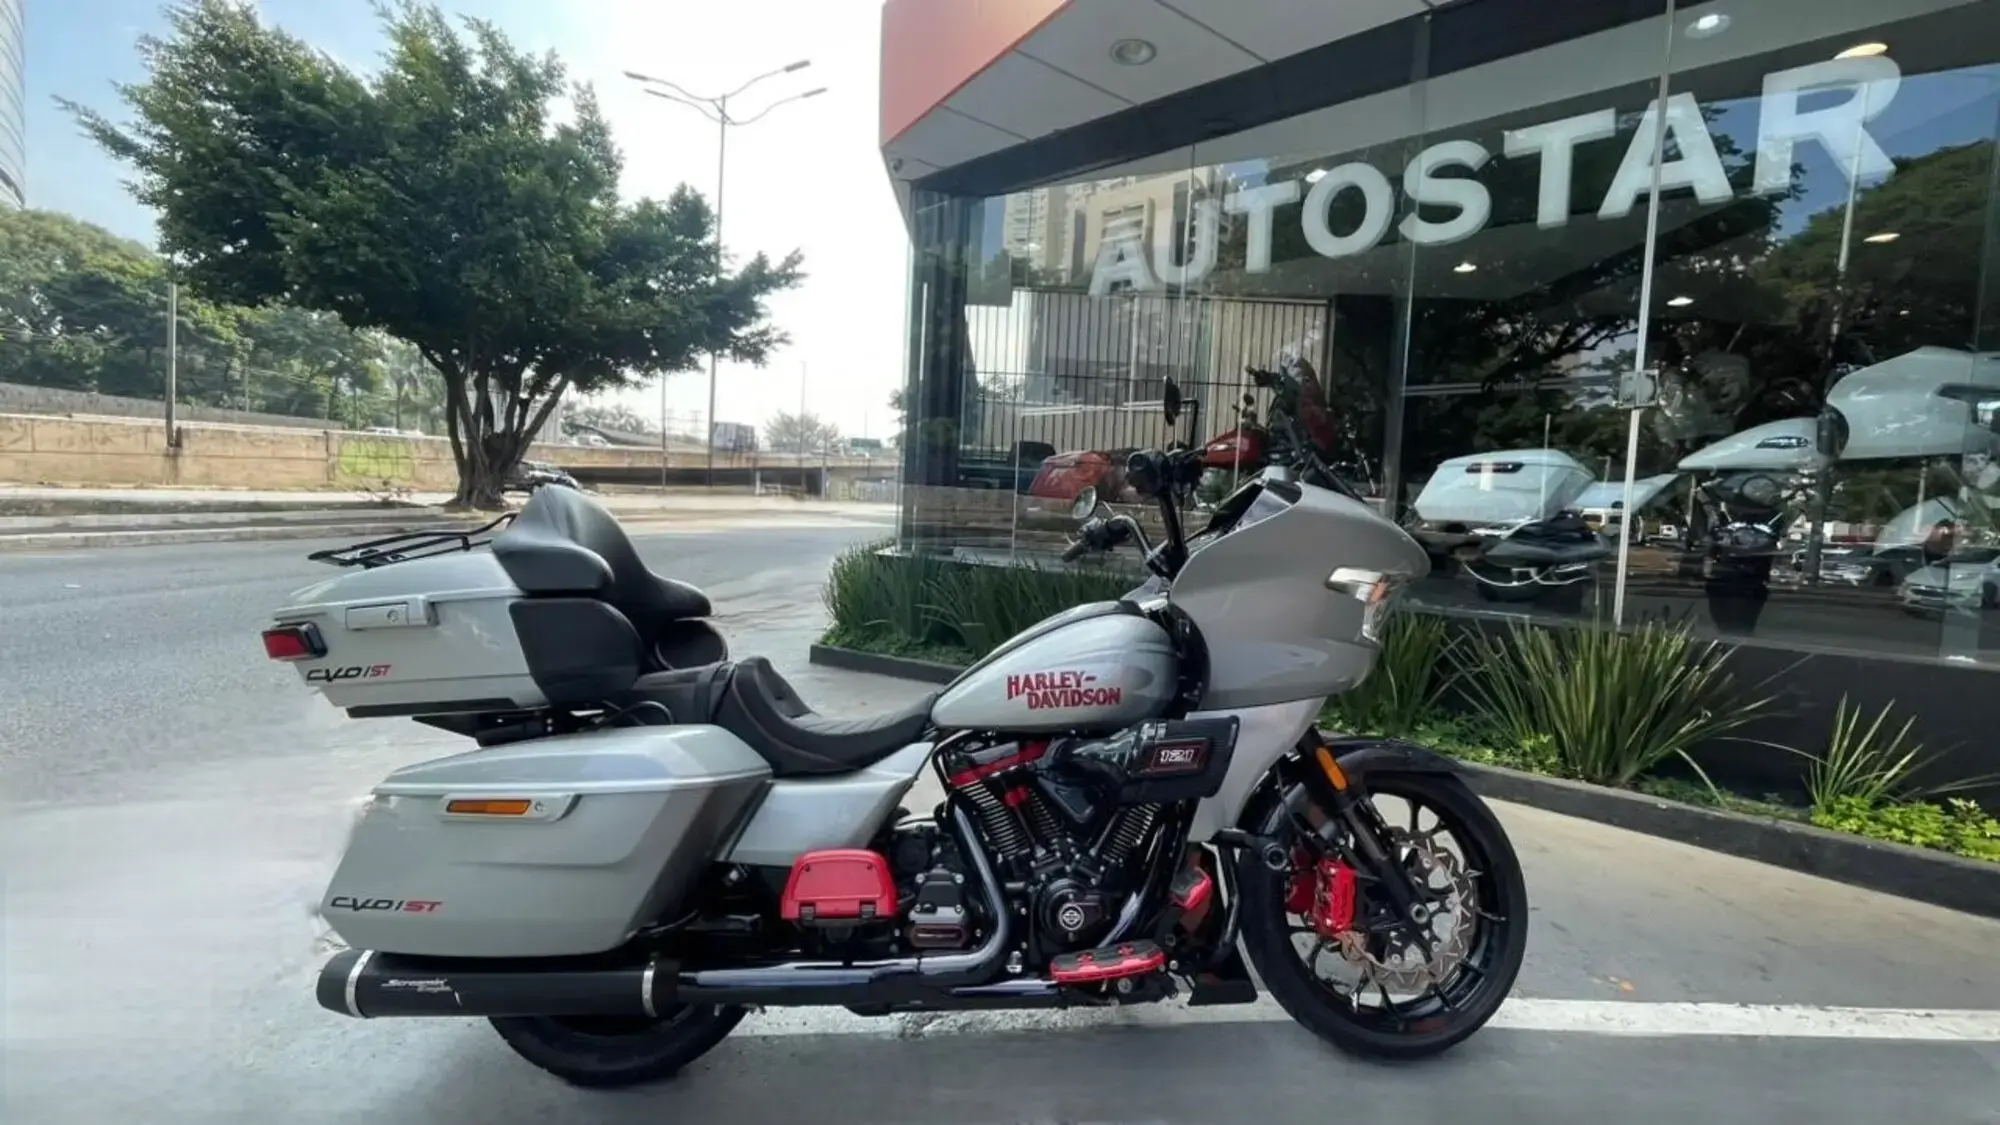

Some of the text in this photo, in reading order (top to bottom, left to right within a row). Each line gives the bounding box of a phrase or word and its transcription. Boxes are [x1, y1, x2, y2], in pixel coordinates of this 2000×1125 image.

[1090, 55, 1902, 297] AUTOSTAR
[1007, 671, 1097, 700] HARLEY-
[1027, 687, 1121, 710] DAVIDSON
